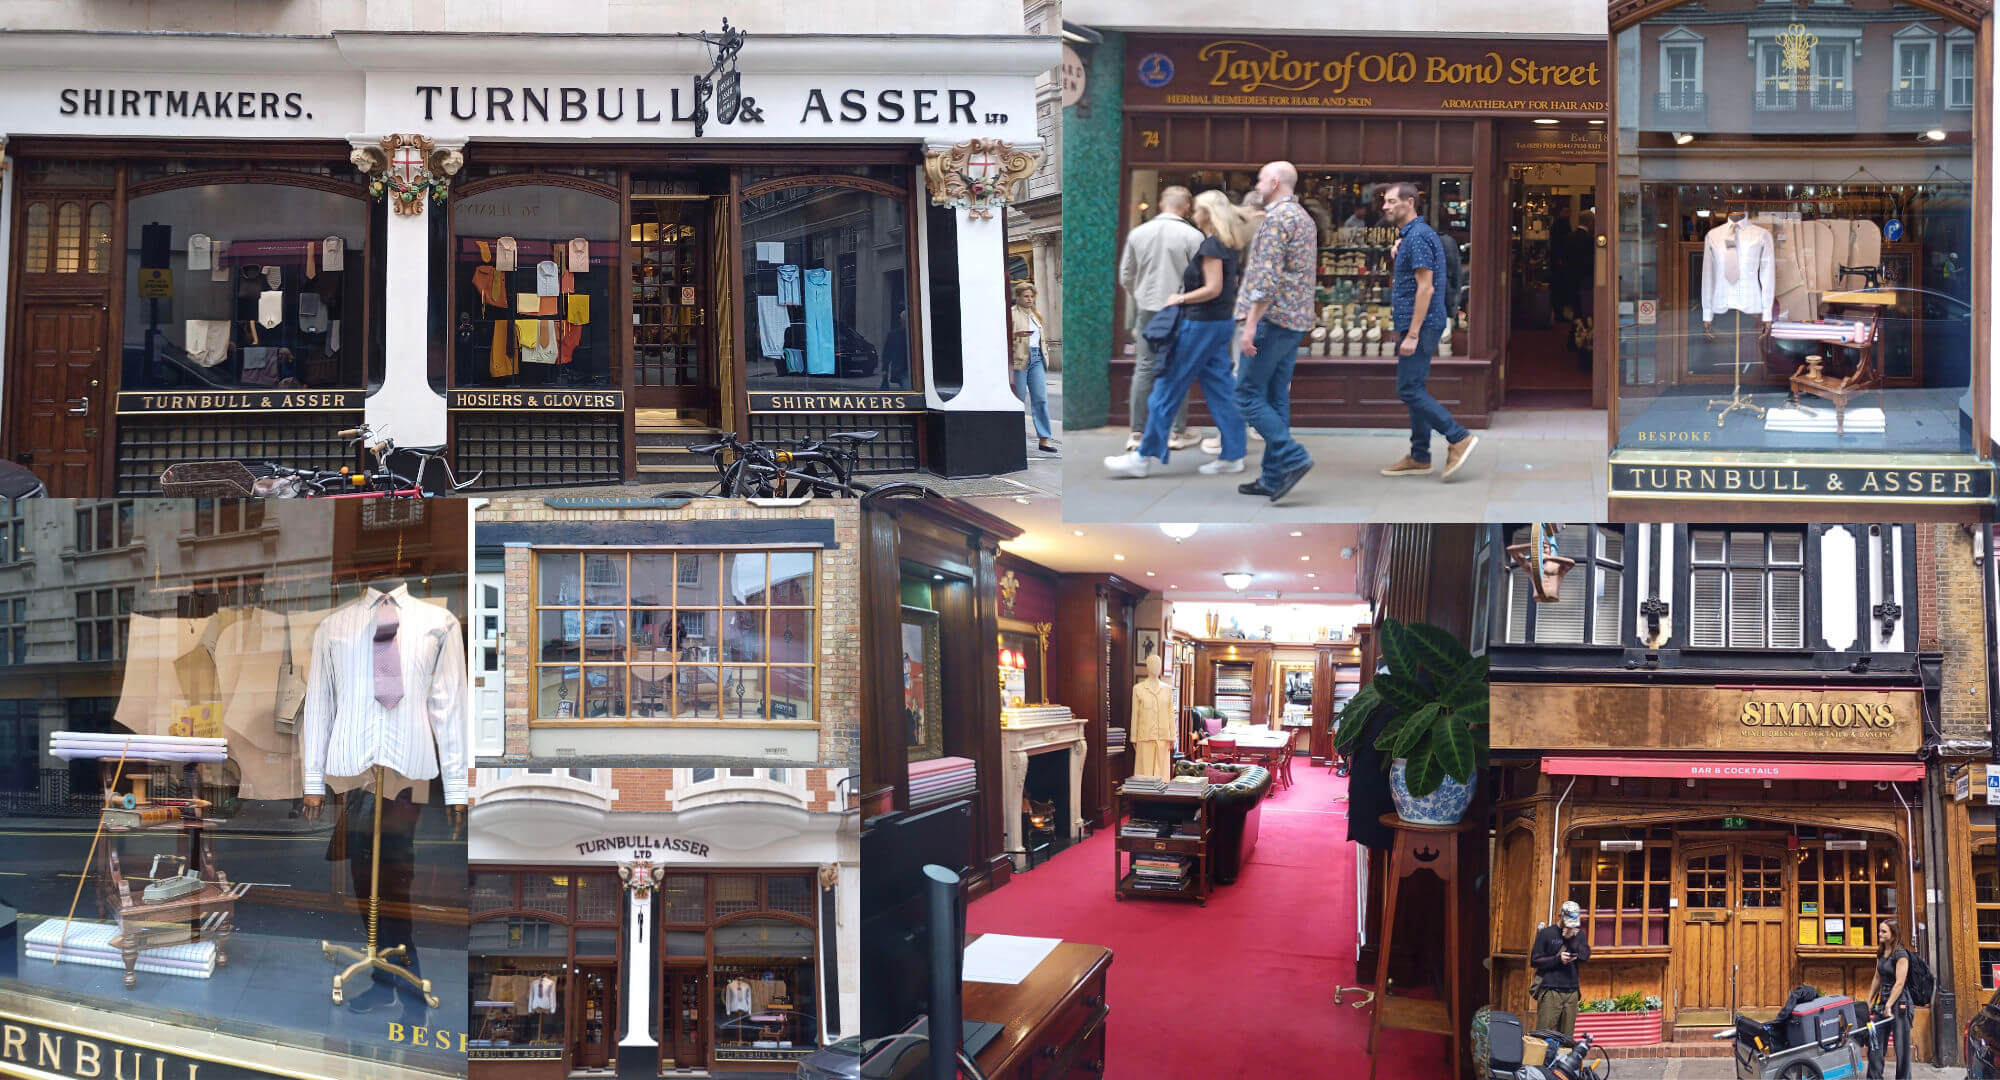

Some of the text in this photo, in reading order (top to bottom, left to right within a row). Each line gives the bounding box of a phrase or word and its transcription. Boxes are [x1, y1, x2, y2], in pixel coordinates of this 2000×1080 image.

[1199, 40, 1601, 94] Taylor of Old Bond Street
[60, 88, 313, 120] SHIRTMAKERS.
[416, 86, 697, 123] TURNBULL
[740, 97, 765, 122] &
[800, 88, 978, 124] ASSER
[1167, 94, 1372, 107] HERBAL REMEDIES FOR HAIR AND SKIN
[1441, 99, 1526, 110] AROMATHERAPY
[1529, 100, 1549, 110] FOR
[1550, 100, 1578, 111] HAIR
[1580, 101, 1603, 111] AND
[985, 112, 1009, 124] LTD
[1142, 130, 1160, 148] 74
[143, 394, 346, 409] TURNBULL & ASSER
[457, 393, 615, 408] HOSIERS & GLOVERS
[772, 396, 906, 409] SHIRTMAKERS
[1638, 431, 1712, 442] BESPOKE
[1629, 467, 1973, 493] TURNBULL & ASSER
[1740, 701, 1895, 728] SIMMONS
[1723, 767, 1779, 775] COCKTAILS
[575, 836, 710, 858] TURNBULL & ASSER
[633, 850, 652, 859] LTD
